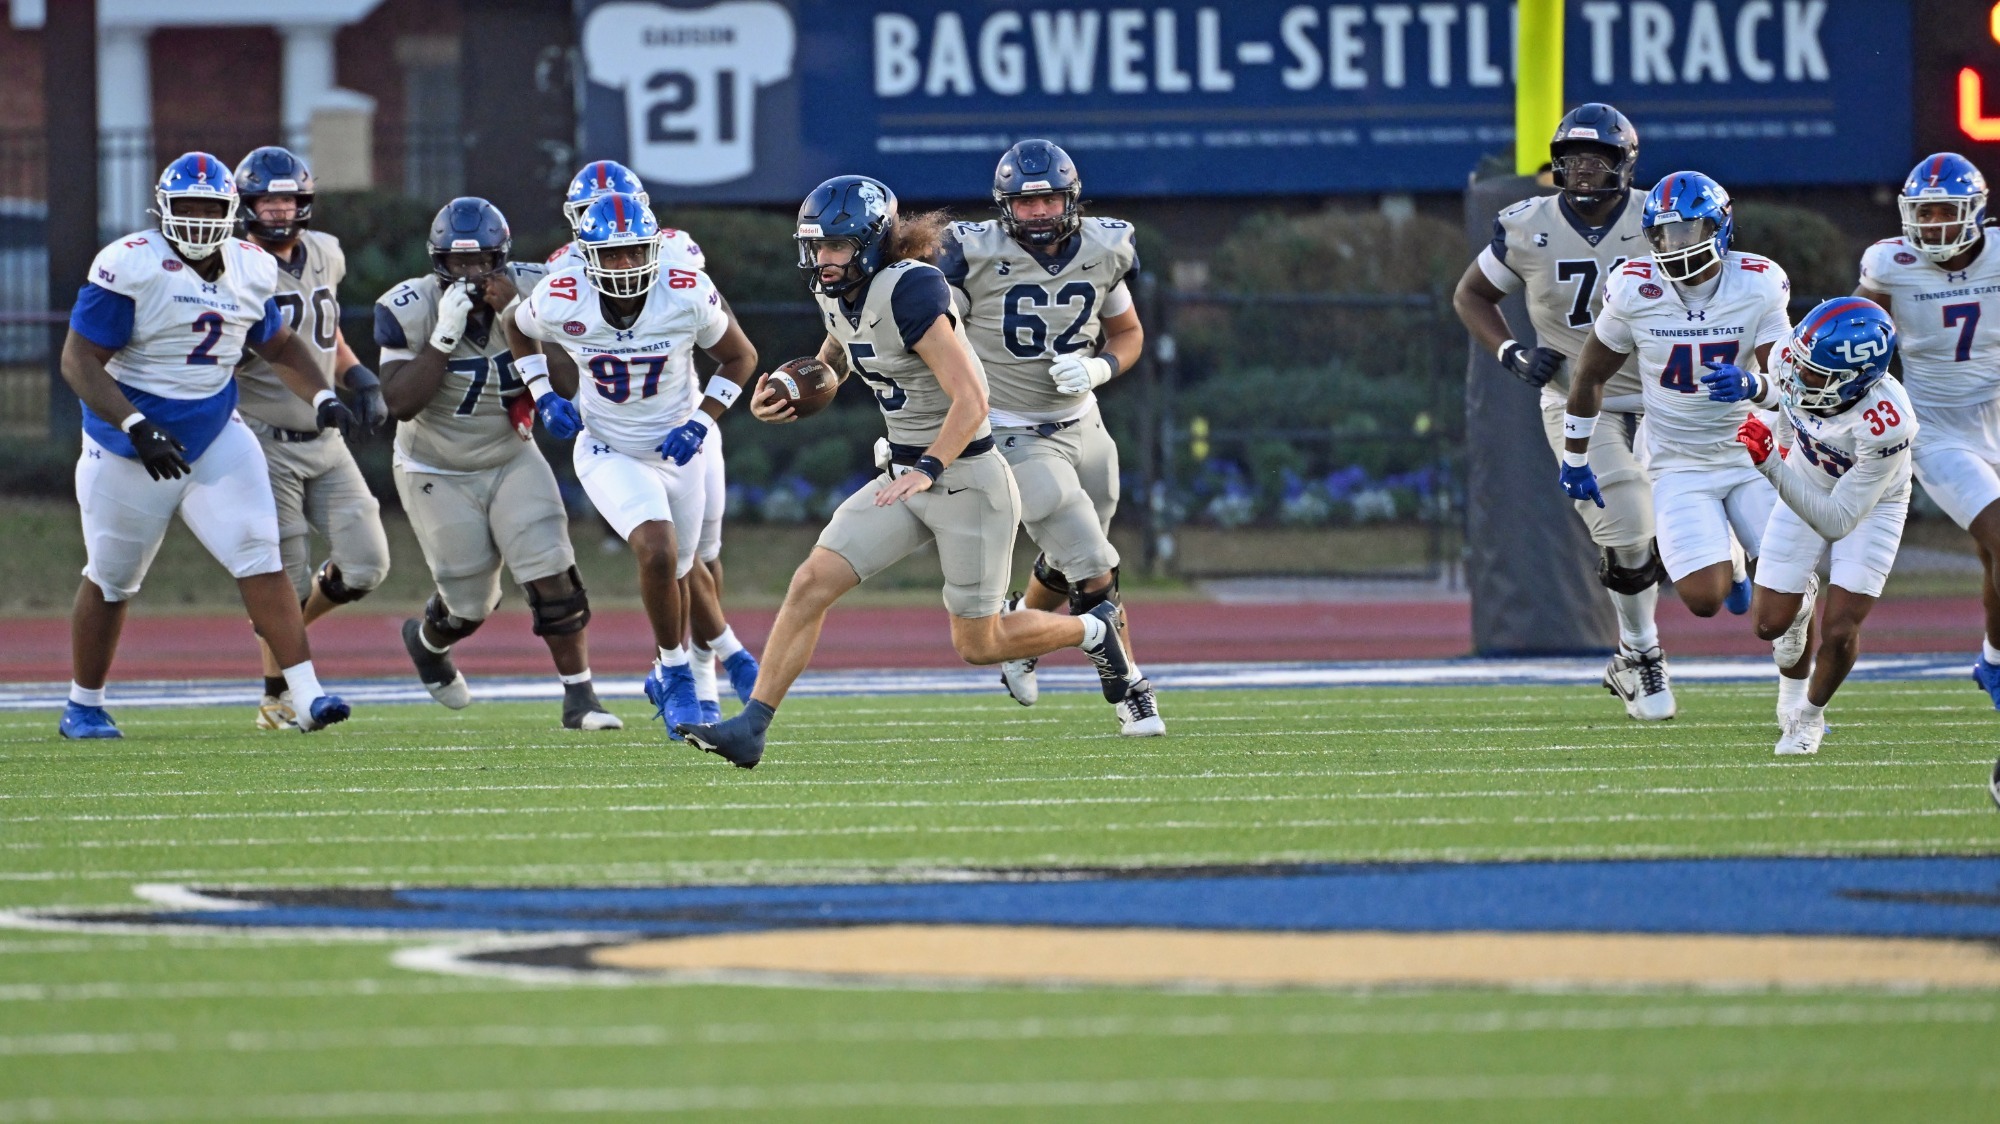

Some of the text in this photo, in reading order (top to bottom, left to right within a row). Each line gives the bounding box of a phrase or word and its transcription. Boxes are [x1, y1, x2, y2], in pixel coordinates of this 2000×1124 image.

[1581, 0, 1830, 85] TRACK
[646, 69, 736, 142] 21
[197, 172, 207, 184] 2
[590, 176, 615, 190] 36
[1930, 175, 1938, 186] 7
[1653, 196, 1679, 212] 47
[607, 218, 633, 234] 97
[1622, 261, 1652, 280] 47
[1741, 257, 1770, 274] 47
[549, 276, 577, 301] 97
[669, 268, 697, 290] 97
[1914, 287, 1970, 302] TENNESSEE
[1002, 281, 1098, 359] 62
[186, 311, 225, 365] 2
[1649, 326, 1745, 338] TENNESSEE STATE
[1941, 302, 1981, 362] 7
[641, 340, 671, 352] STATE
[1836, 334, 1888, 364] tsu
[588, 353, 669, 404] 97
[847, 341, 910, 414] 5
[1863, 400, 1901, 437] 33
[1878, 438, 1909, 458] tsu
